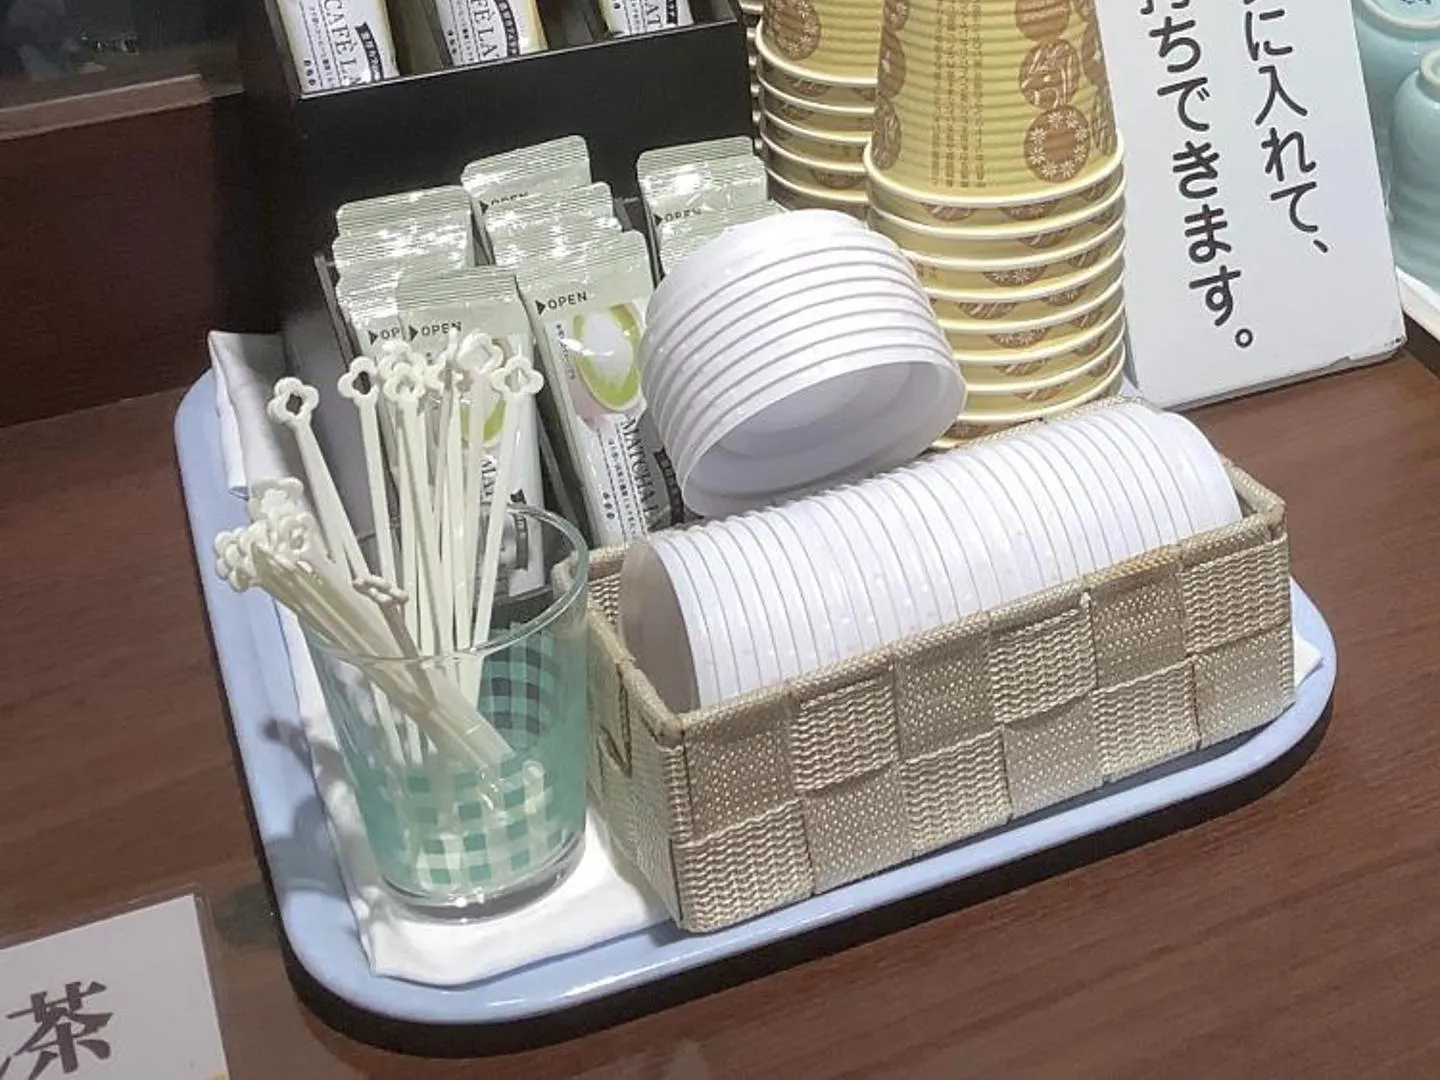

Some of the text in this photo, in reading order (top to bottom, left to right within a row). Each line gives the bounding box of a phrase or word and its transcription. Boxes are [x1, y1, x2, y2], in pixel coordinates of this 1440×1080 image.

[476, 26, 500, 61] LA
[548, 291, 588, 310] OPEN
[421, 321, 462, 337] OPEN
[621, 416, 656, 504] MATCHA
[6, 980, 113, 1080] 茶
